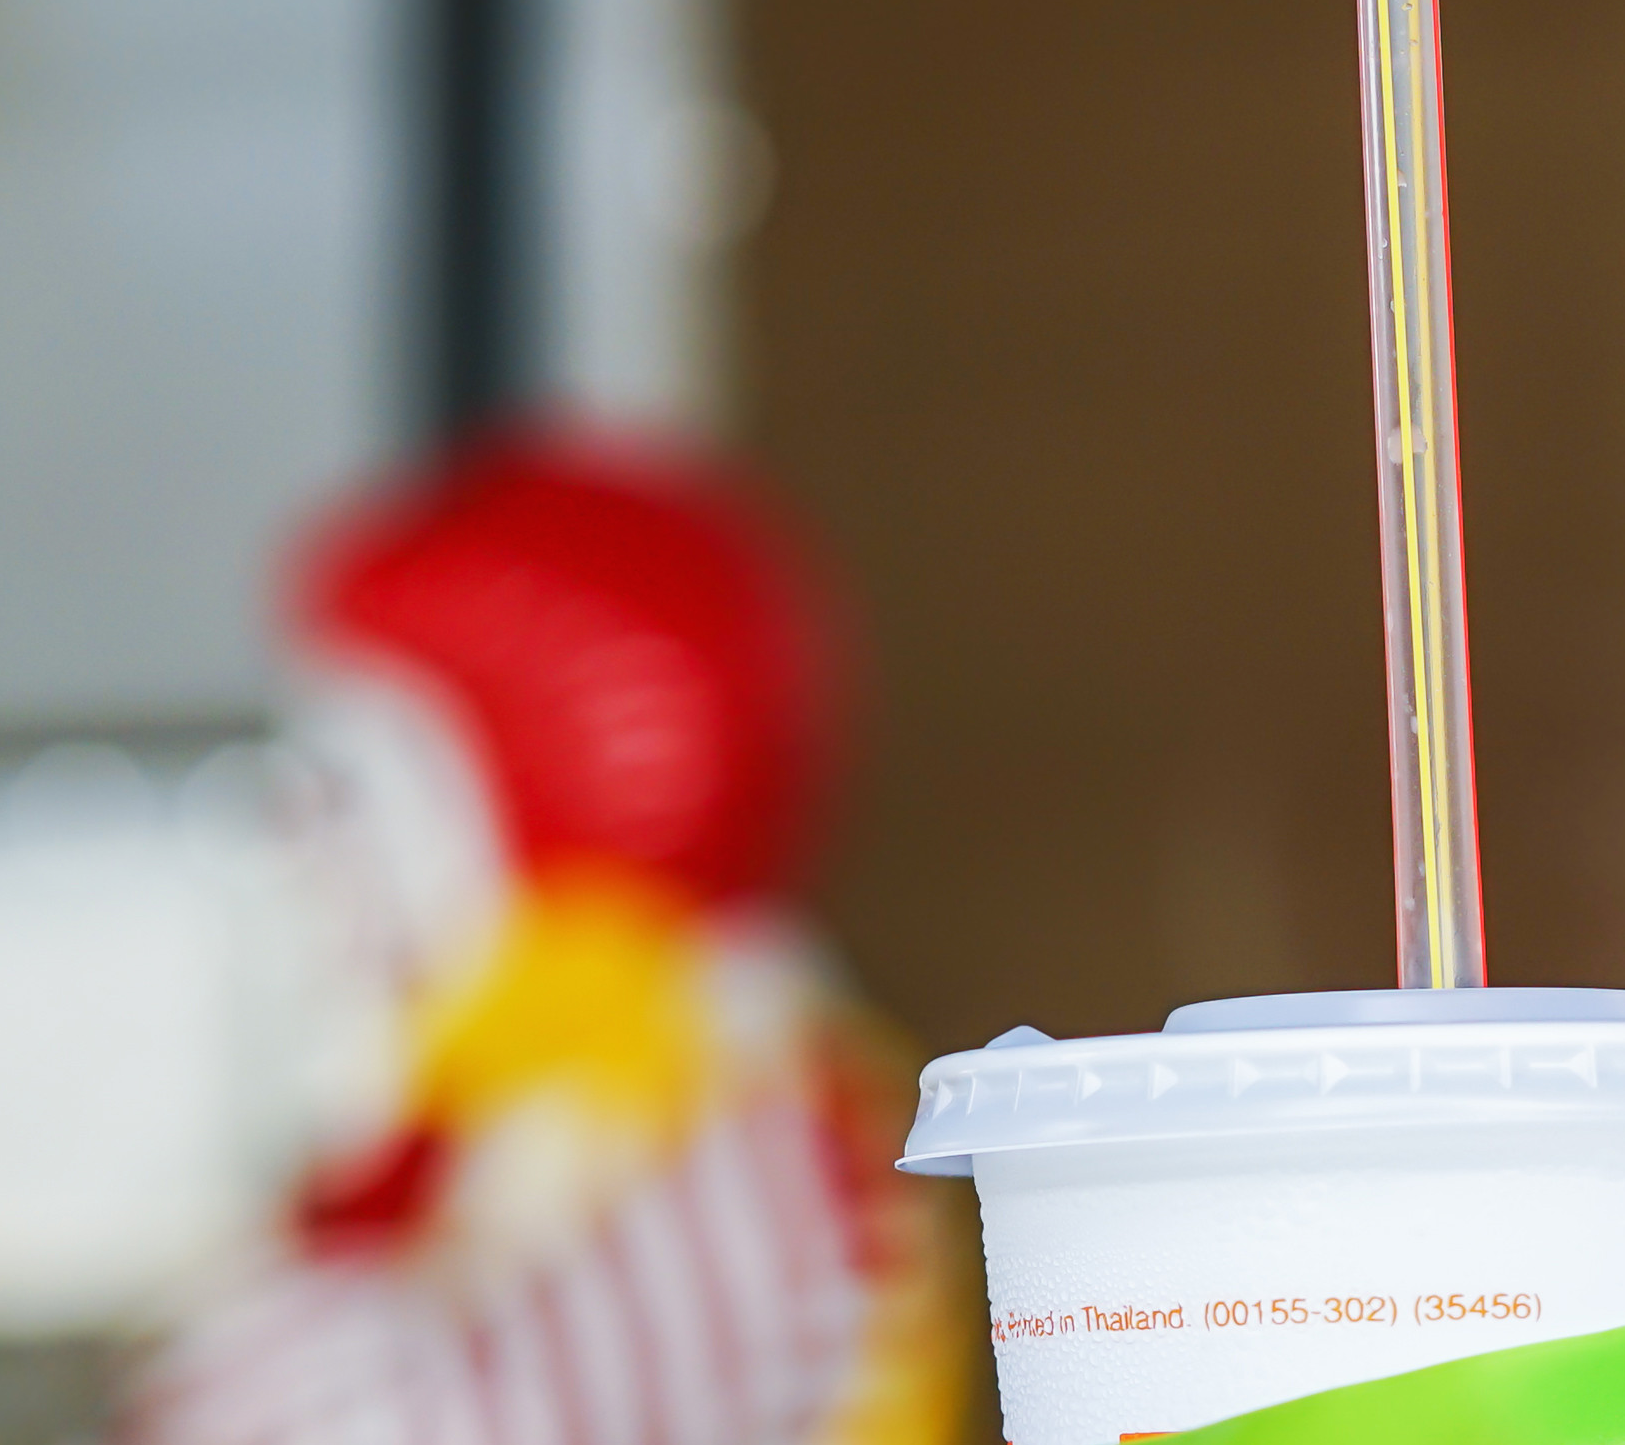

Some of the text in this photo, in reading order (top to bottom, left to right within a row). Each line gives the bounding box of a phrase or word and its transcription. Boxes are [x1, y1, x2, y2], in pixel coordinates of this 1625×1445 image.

[1059, 1310, 1075, 1334] in
[1204, 1295, 1399, 1332] (00155-302)
[1413, 1292, 1543, 1326] (35456)
